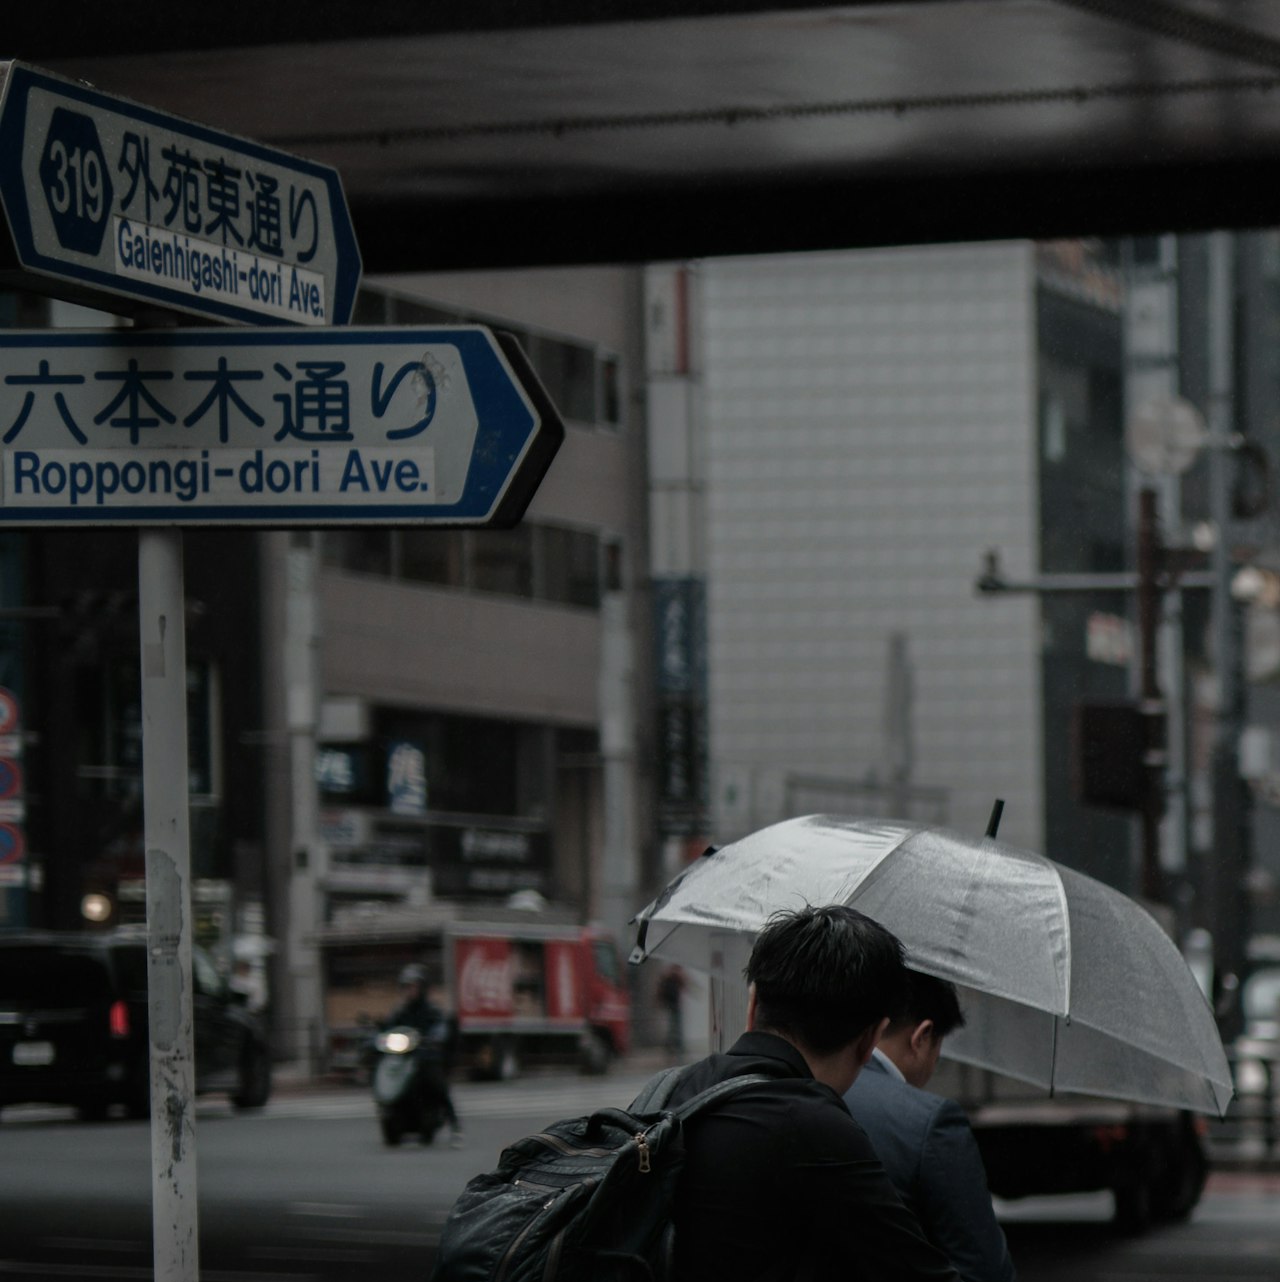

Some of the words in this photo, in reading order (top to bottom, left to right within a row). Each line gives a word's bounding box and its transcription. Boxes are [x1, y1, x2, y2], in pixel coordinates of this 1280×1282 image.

[50, 139, 104, 224] 319
[118, 130, 319, 263] 外苑東通り
[118, 220, 282, 302] Gaienhigashi-dori
[289, 266, 324, 318] Ave.
[2, 355, 438, 445] 六本木通り
[13, 450, 320, 504] Roppongi-dori
[339, 449, 429, 493] Ave.
